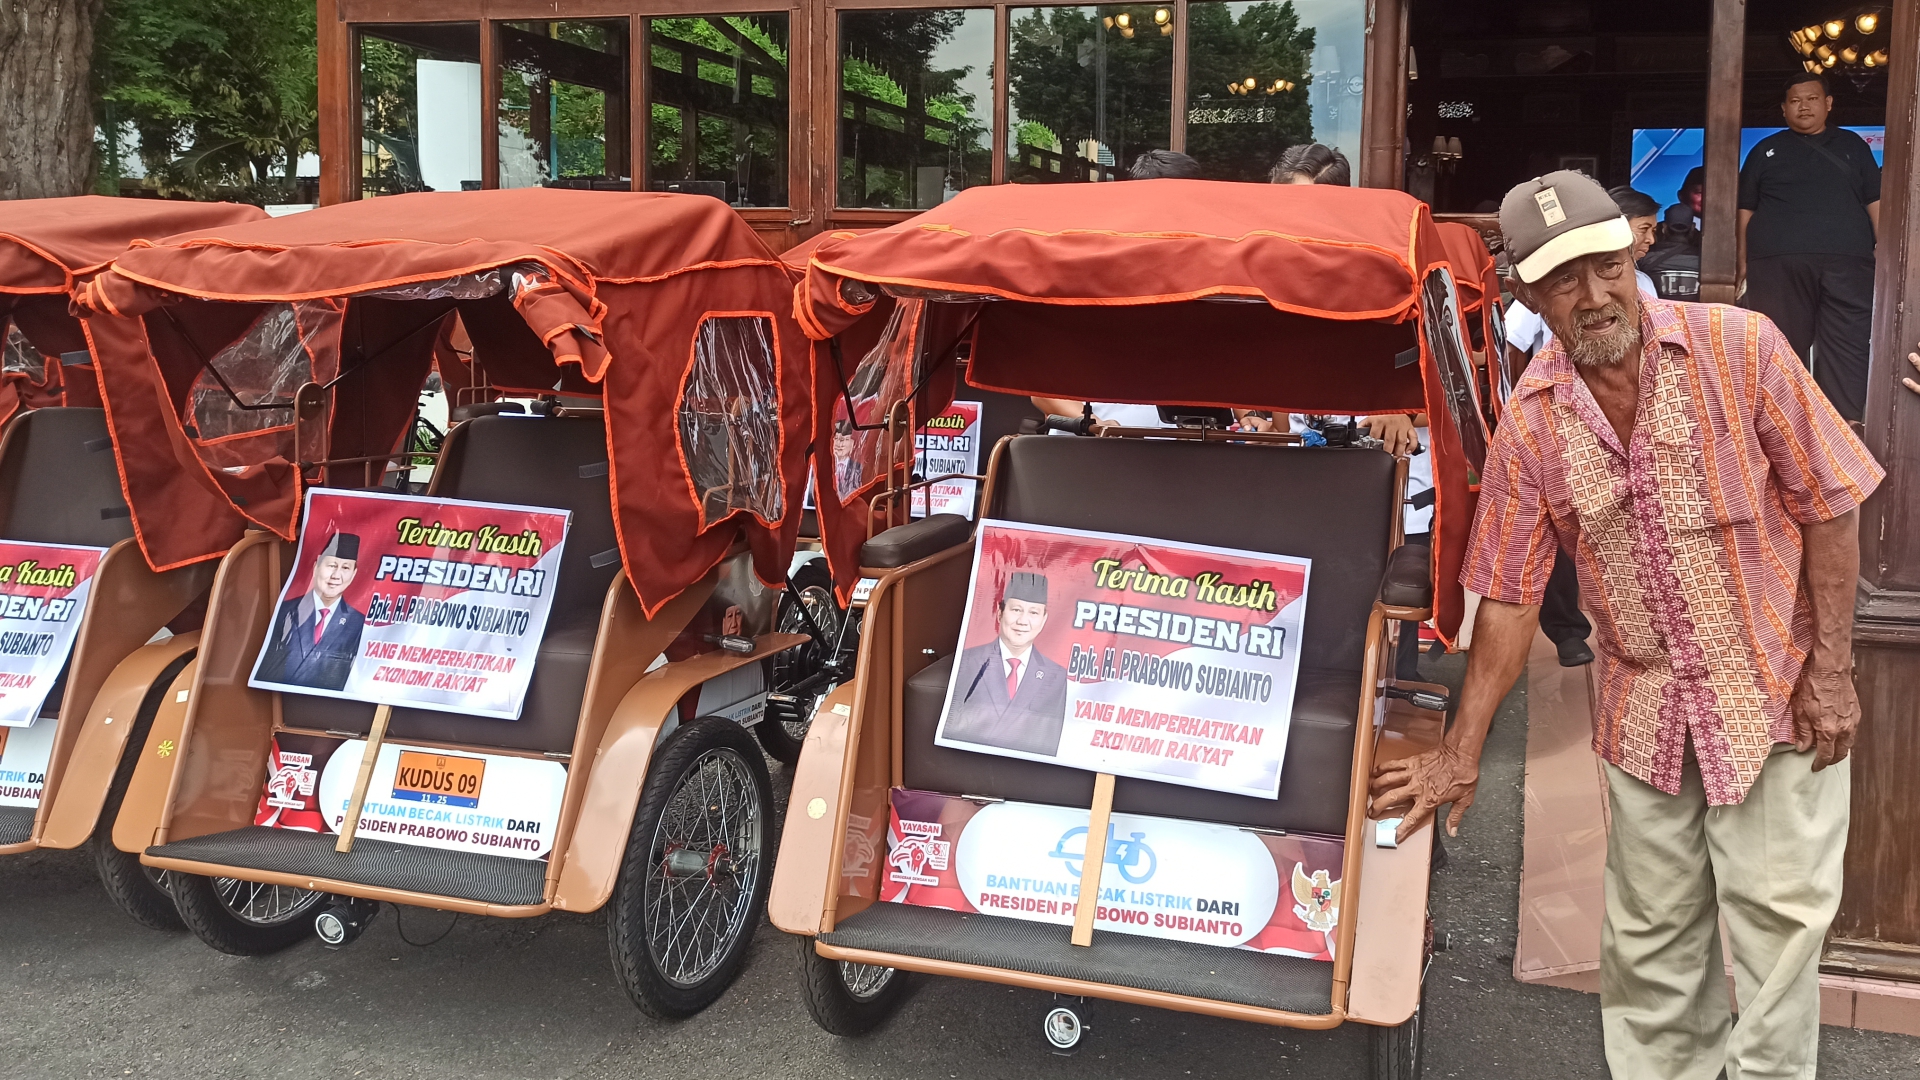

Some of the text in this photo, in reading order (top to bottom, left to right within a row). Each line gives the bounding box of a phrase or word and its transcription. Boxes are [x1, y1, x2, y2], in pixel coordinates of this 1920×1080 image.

[952, 436, 971, 452] RI
[929, 458, 966, 473] SUBIANTO
[397, 517, 543, 556] Terima Kasih
[16, 560, 76, 588] Kasih
[375, 556, 545, 597] PRESIDEN RI
[1092, 559, 1277, 611] Terima Kasih
[43, 598, 77, 622] RI
[367, 594, 530, 637] Bpk. H. PRABOWO SUBIANTO
[1073, 602, 1285, 658] PRESIDEN RI
[365, 641, 516, 674] YANG MEMPERHATIKAN
[1068, 645, 1273, 703] Bpk. H. PRABOWO SUBIANTO
[373, 666, 487, 693] EKONOMI RAKYAT
[1074, 700, 1264, 746] YANG MEMPERHATIKAN
[281, 754, 310, 764] YAYASAN
[1090, 730, 1234, 767] EKONOMI RAKYAT
[28, 772, 44, 784] DA
[399, 767, 477, 795] KUDUS 09
[335, 815, 541, 852] PSIDEN PRABOWO SUBIANTO
[342, 799, 541, 834] BNTUAN BECAK LISTRIK DARI
[902, 822, 940, 833] YAYASAN
[986, 874, 1067, 897] BANTUAN
[1130, 891, 1192, 911] LISTRIK
[1196, 898, 1239, 916] DARI
[980, 893, 1242, 937] PRESIDEN PBOWO SUBIANTO
